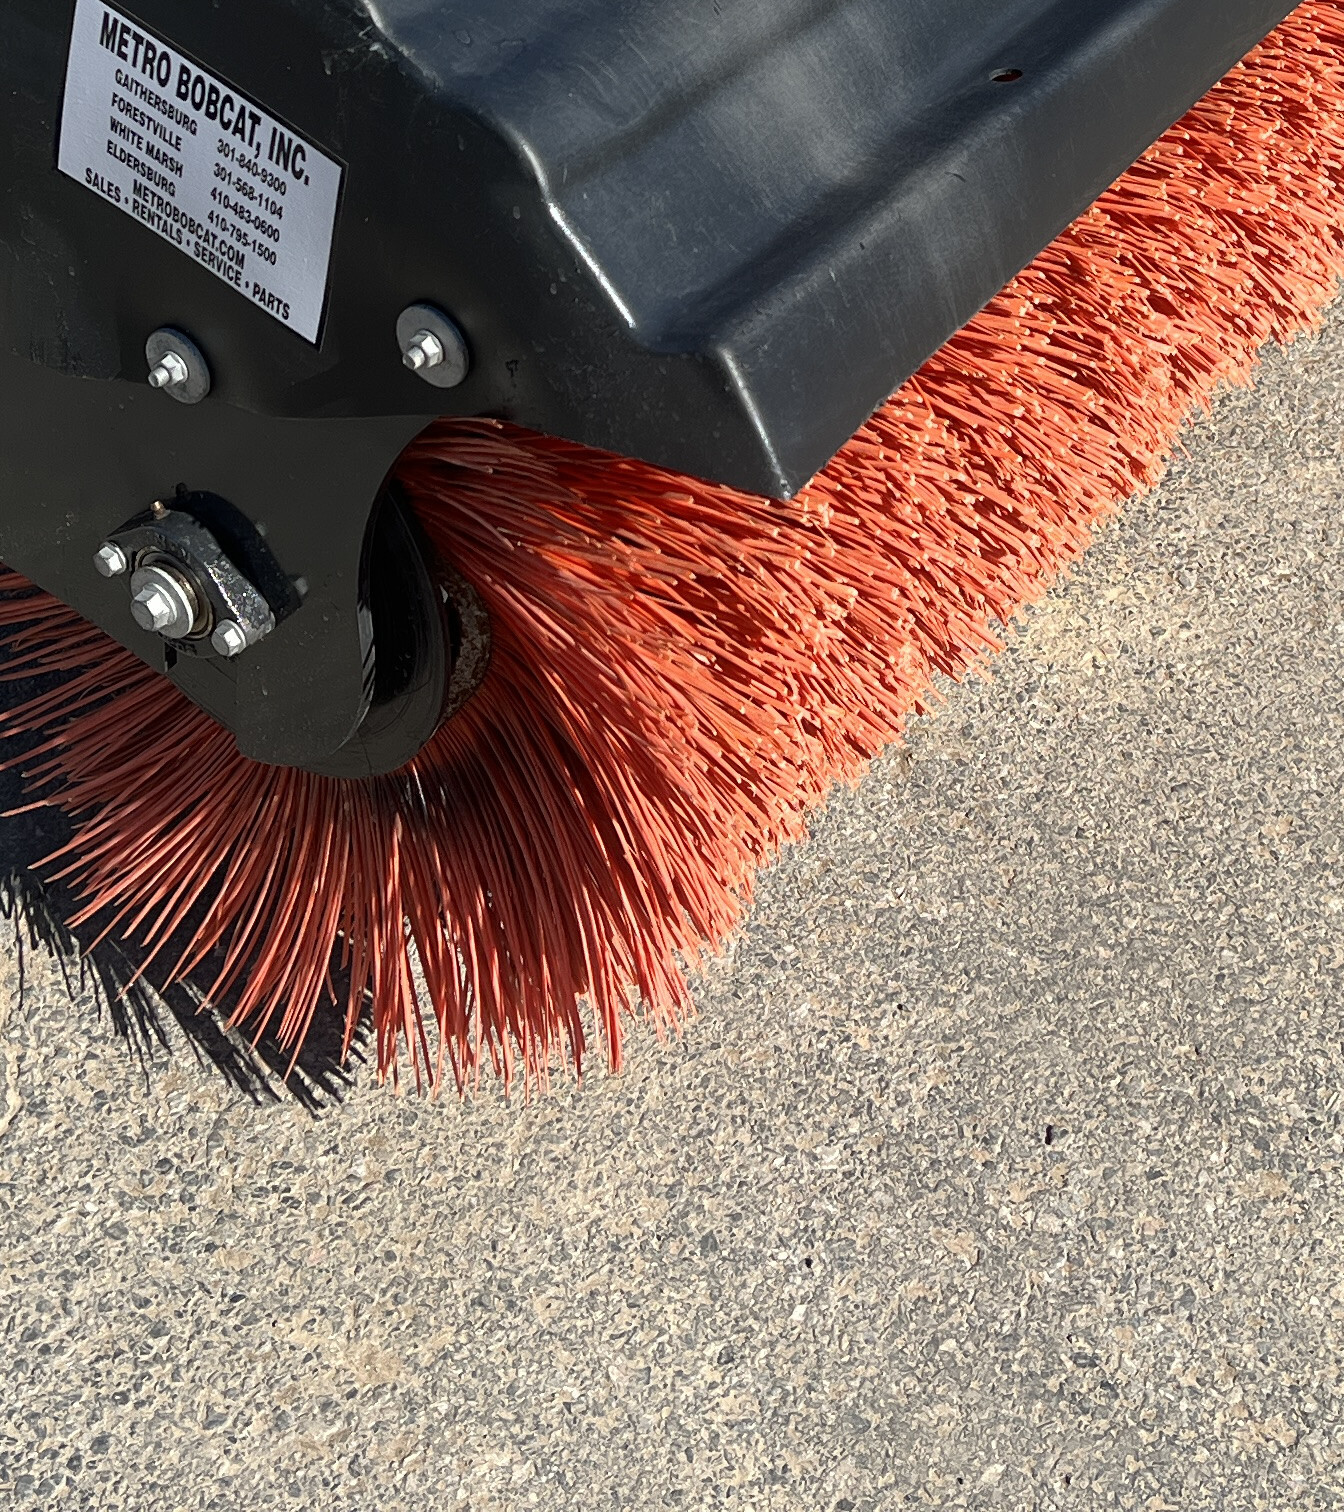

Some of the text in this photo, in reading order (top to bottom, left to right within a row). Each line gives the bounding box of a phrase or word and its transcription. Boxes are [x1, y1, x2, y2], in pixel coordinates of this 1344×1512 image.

[99, 10, 310, 187] METRO BOBCAT, INC.
[110, 115, 144, 151] WHITE
[145, 140, 184, 178] MARSH
[111, 91, 284, 220] FORESTVILLE 301-568-1104
[115, 68, 287, 196] GAITHERSBURG 301-840-9300
[85, 167, 290, 321] SALES RENTALS SERVICE PARTS
[106, 139, 277, 266] ELDERSBURG 410-795-1500
[132, 178, 246, 270] METROBOBCAT.COM
